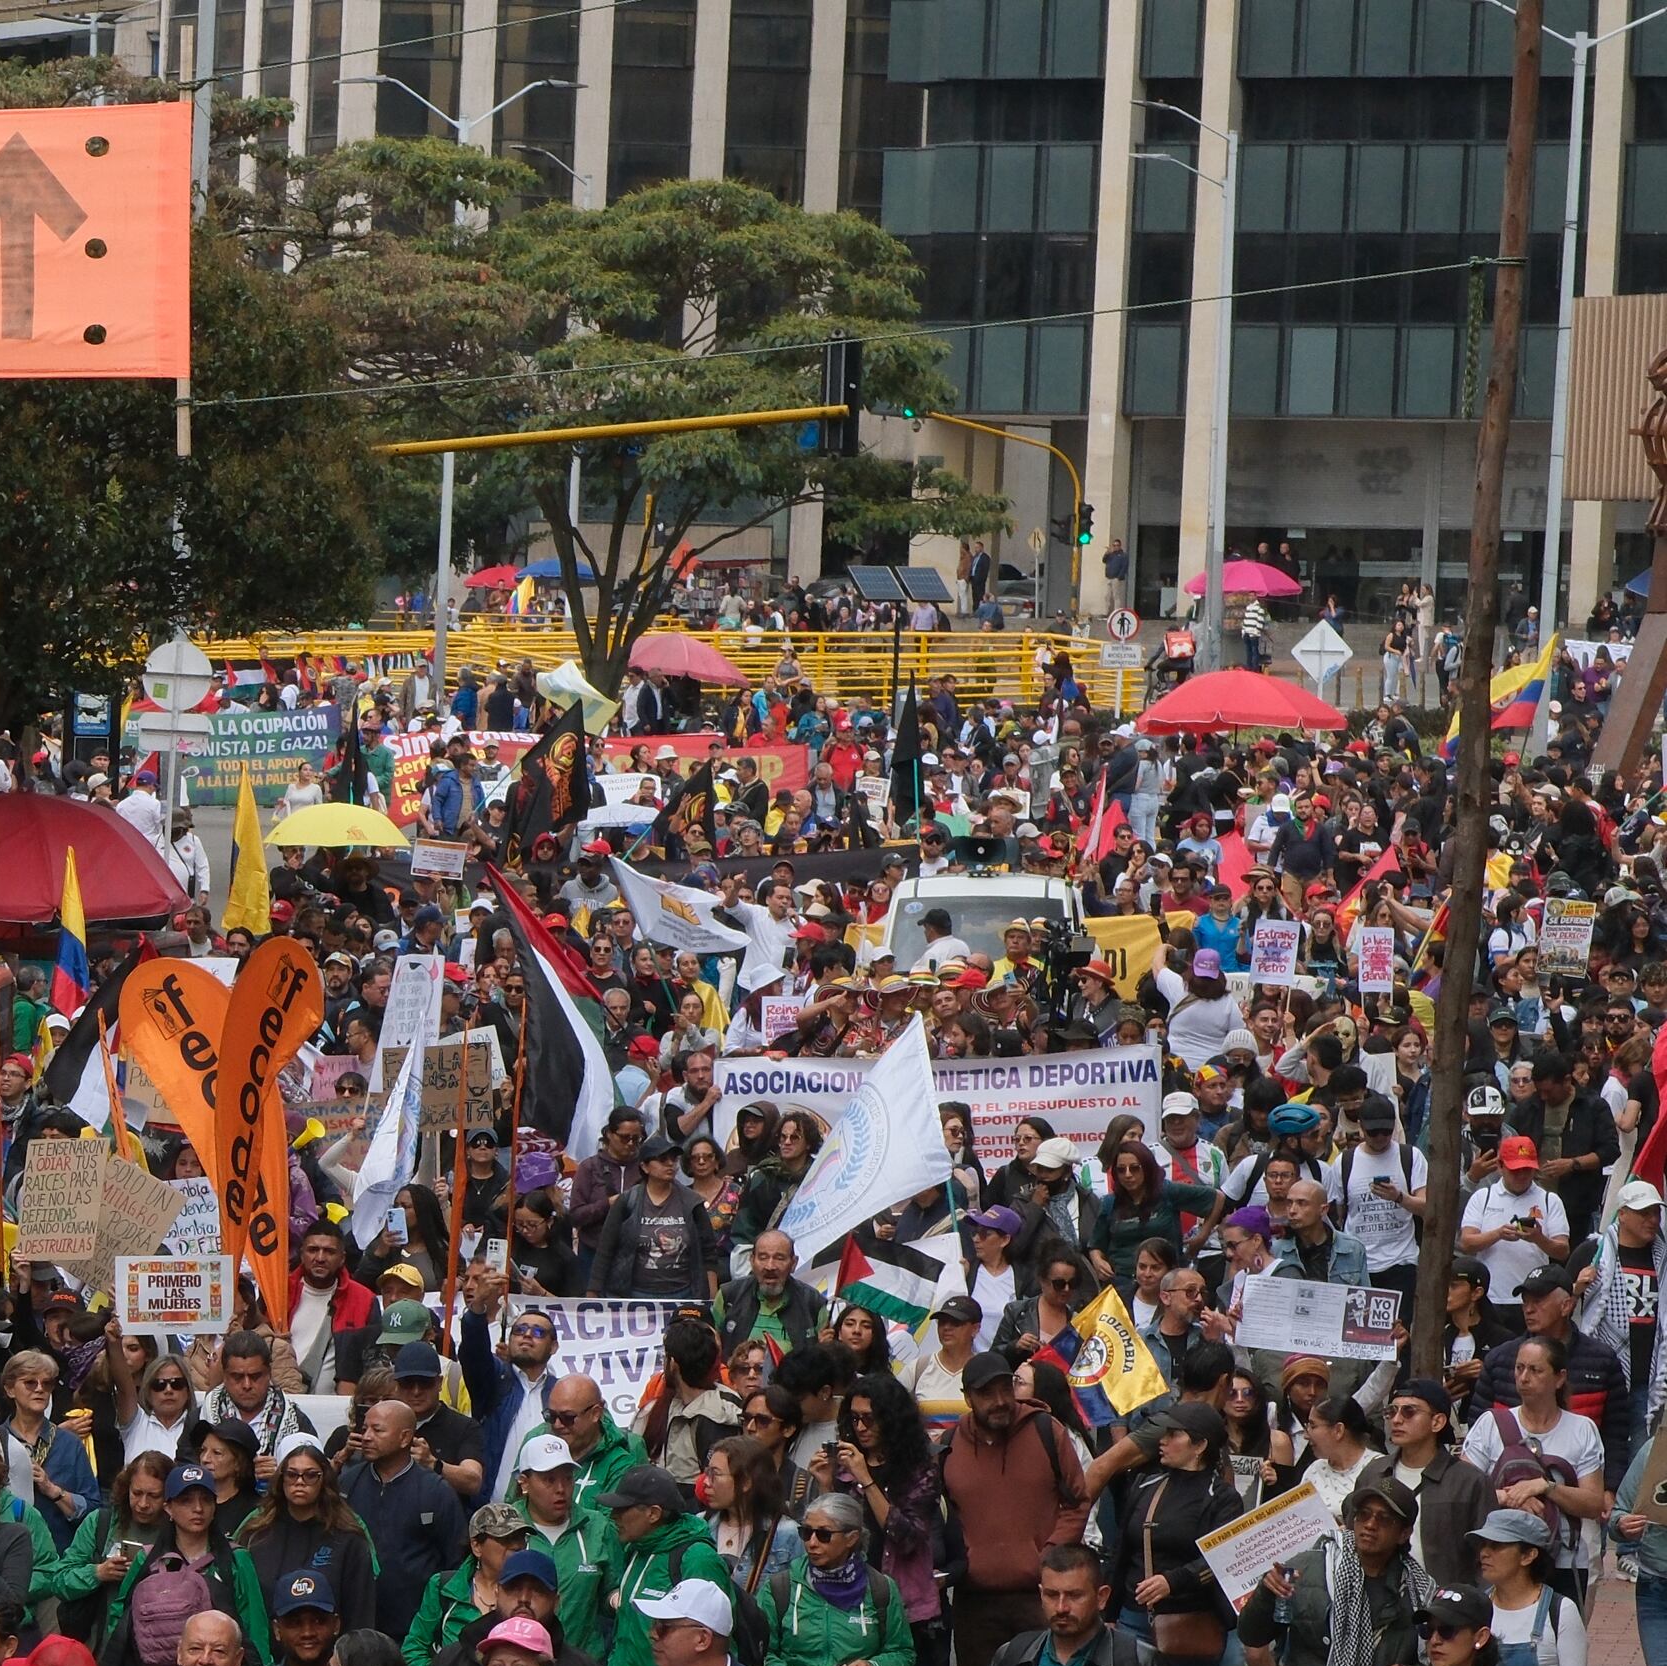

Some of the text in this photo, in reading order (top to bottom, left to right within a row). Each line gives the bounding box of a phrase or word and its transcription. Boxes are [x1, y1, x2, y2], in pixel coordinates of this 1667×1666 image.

[241, 711, 328, 734] OCUPACIÓN
[256, 736, 328, 753] DE GAZA!
[1257, 929, 1297, 941] Extraño
[1258, 963, 1286, 974] Petro
[1029, 1059, 1158, 1087] DEPORTIVA
[723, 1071, 864, 1095] ASOCIACION
[225, 967, 308, 1228] fecode
[986, 1096, 1141, 1112] EL PRESUPUESTO AL
[30, 1139, 105, 1157] TE ENSEÑARON
[36, 1154, 97, 1171] ODIAR TUS
[24, 1172, 99, 1192] RAICES PARA
[23, 1189, 92, 1209] QUE NO LAS
[147, 1185, 174, 1213] UN
[22, 1207, 77, 1224] DEFIENDAS
[20, 1221, 96, 1236] CUANDO VENGAN
[25, 1238, 92, 1255] DESTRUIRLAS
[147, 1275, 202, 1288] PRIMERO
[164, 1288, 185, 1299] LAS
[147, 1299, 202, 1311] MUJERES
[1374, 1299, 1391, 1310] YO
[1372, 1309, 1390, 1321] NO
[1099, 1313, 1135, 1374] COLOMBIA
[515, 1620, 531, 1635] 17
